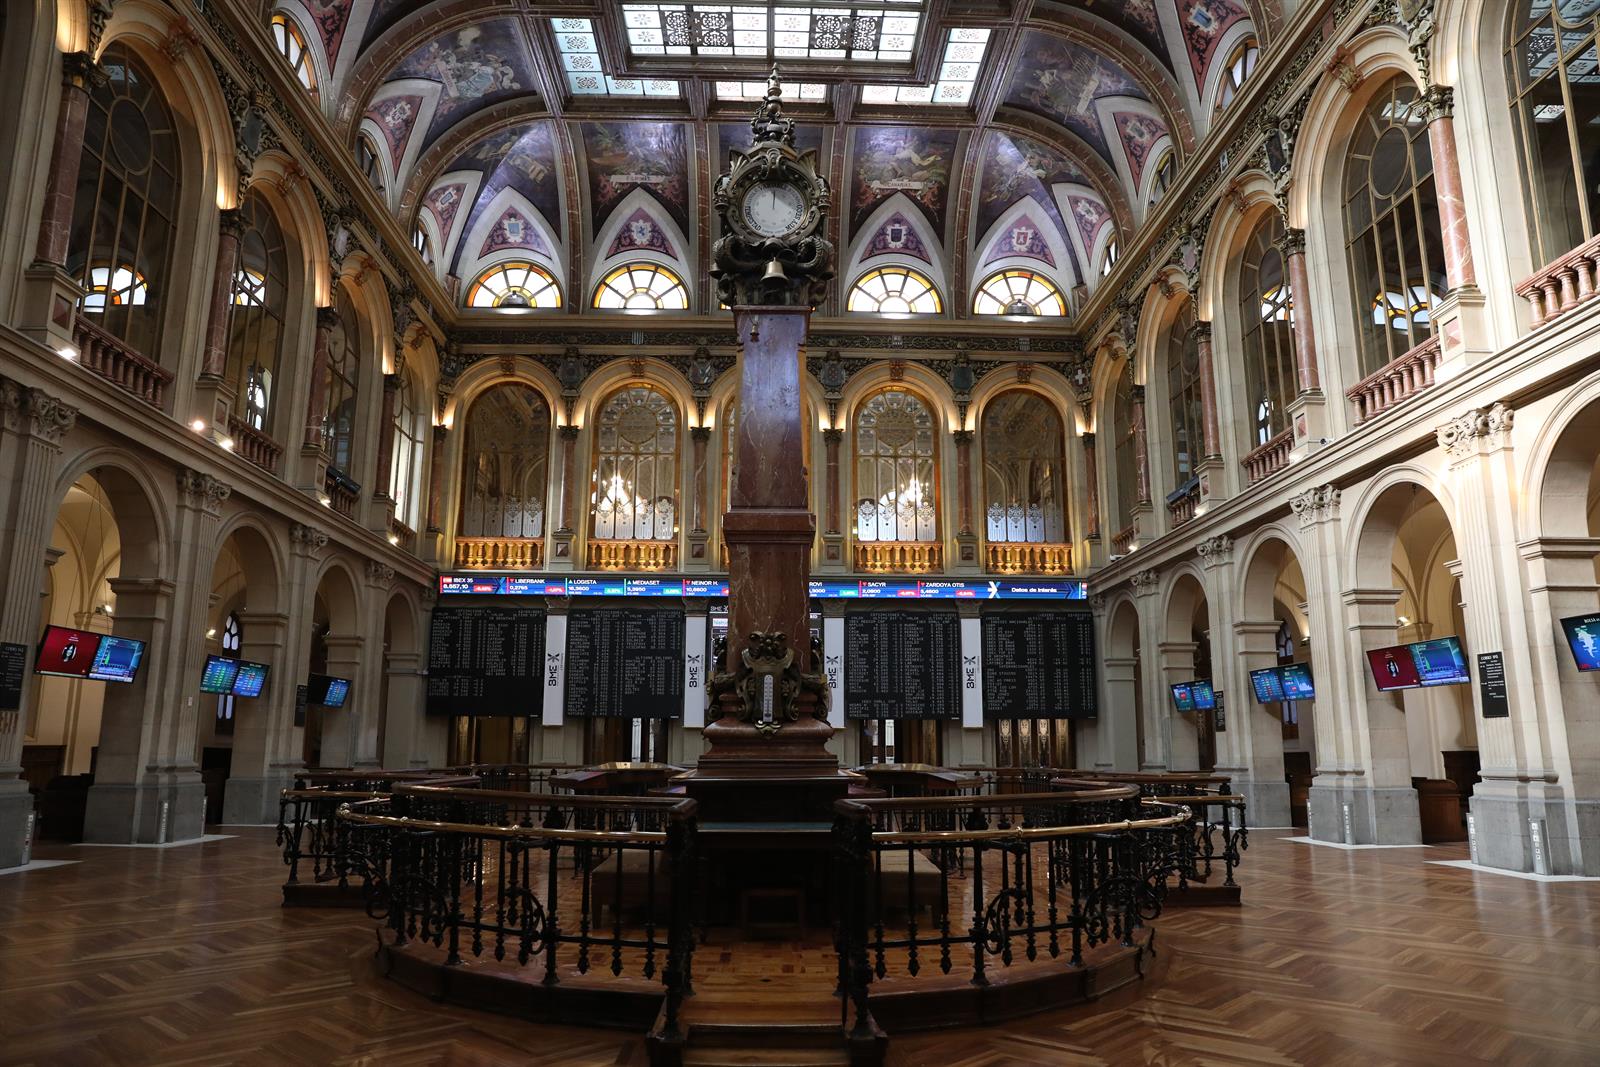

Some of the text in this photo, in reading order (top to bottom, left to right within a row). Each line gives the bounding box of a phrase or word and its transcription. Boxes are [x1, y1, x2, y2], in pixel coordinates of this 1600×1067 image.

[785, 219, 798, 231] MUY
[548, 665, 557, 686] BME
[688, 666, 698, 687] BME
[828, 667, 837, 689] BME
[966, 667, 976, 689] BME
